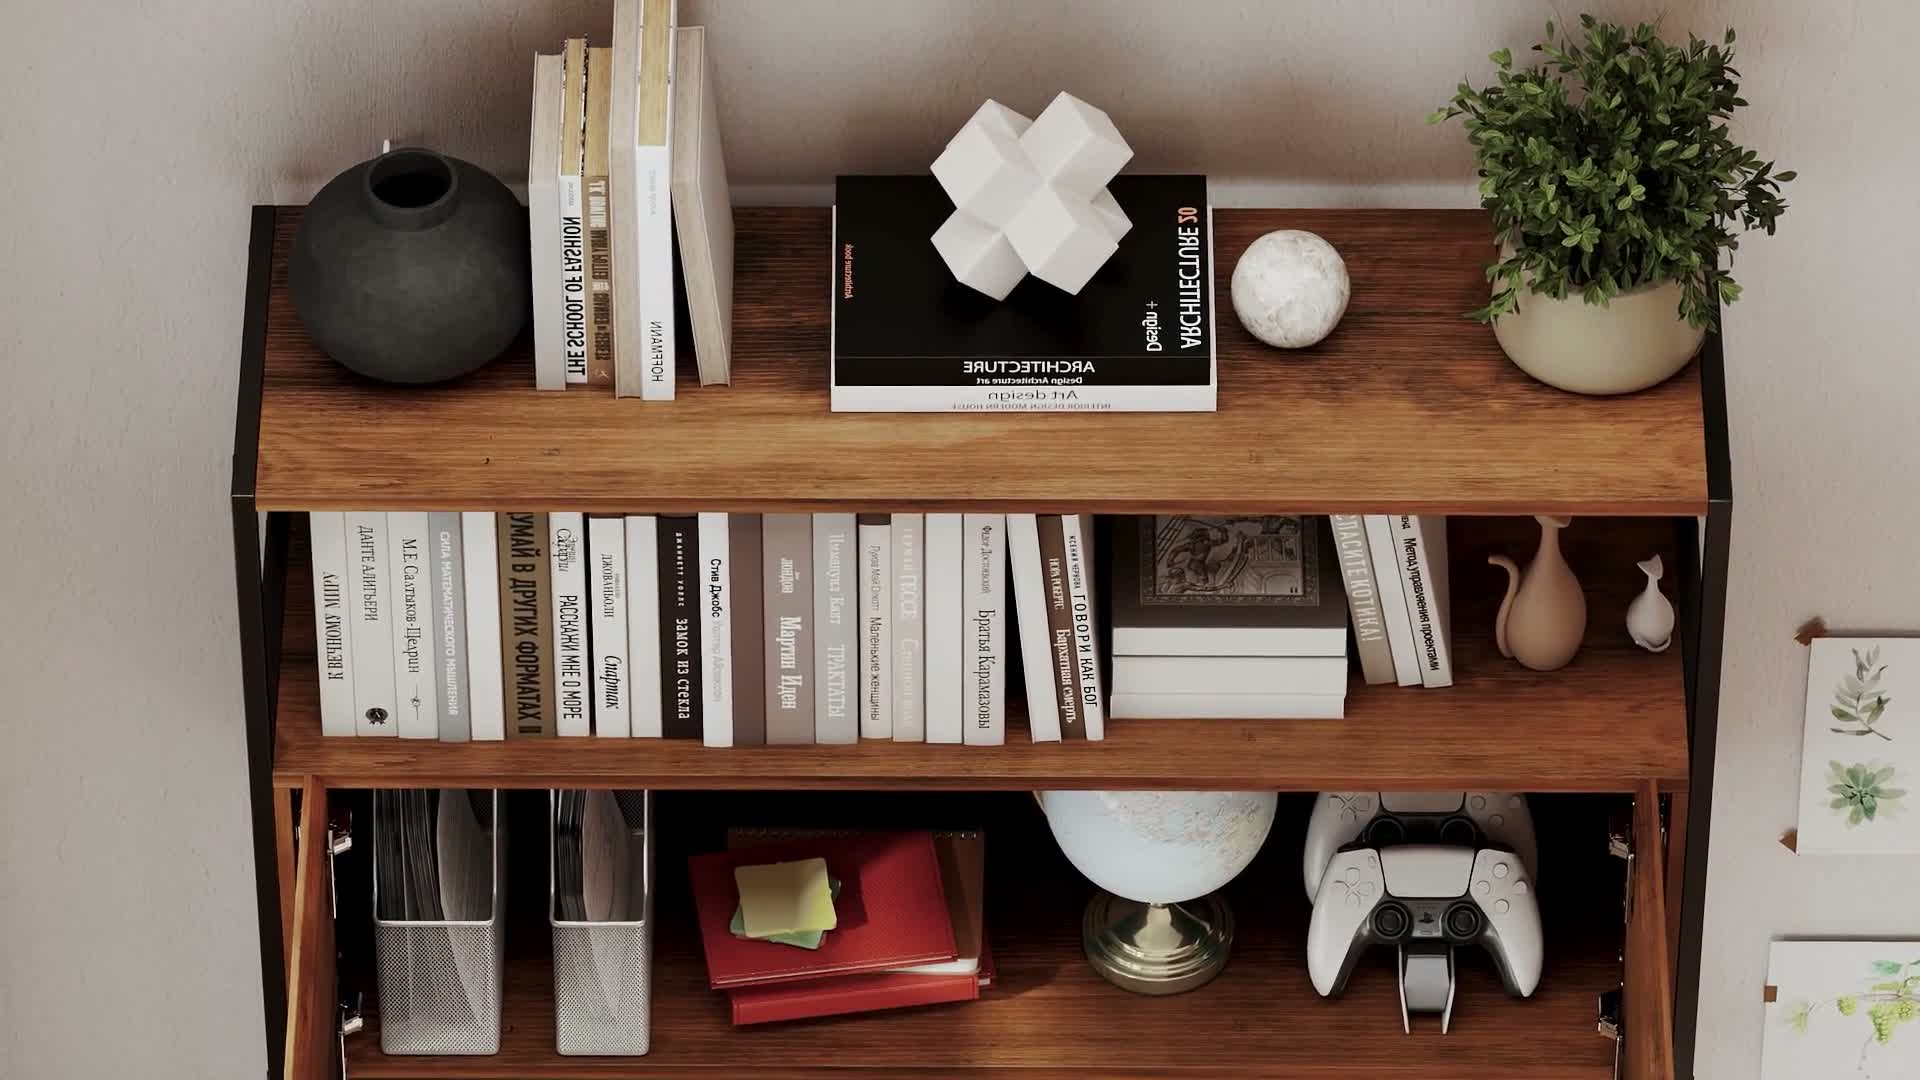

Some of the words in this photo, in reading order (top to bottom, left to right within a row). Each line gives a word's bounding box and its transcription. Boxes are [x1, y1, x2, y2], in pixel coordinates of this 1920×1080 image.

[359, 525, 375, 563] ДАНТЕ
[403, 538, 418, 563] М.Е.
[440, 531, 452, 559] СИЛА
[512, 563, 536, 573] В
[1403, 537, 1418, 566] Метод
[362, 565, 378, 621] АЛИГЬЕРИ
[602, 553, 615, 618] ДЖОВАНЬОЛИ
[710, 558, 721, 582] Стив
[1409, 566, 1430, 623] управления
[403, 565, 420, 673] Салтыков-Щедрин
[440, 560, 456, 657] МАТЕМАТИЧЕСКОГО
[510, 578, 538, 637] ДРУГИХ
[710, 585, 722, 618] Джобс
[830, 597, 844, 624] Кант
[1051, 581, 1065, 610] РОБЕРТС
[1351, 579, 1383, 641] КОТИКА!
[325, 613, 344, 670] ВЕЧНОМУ
[559, 595, 580, 651] РАССКАЖИ
[776, 616, 802, 668] Мартин
[870, 617, 882, 671] Маленькие
[973, 609, 995, 652] Братья
[1074, 595, 1092, 654] ГОВОРИ
[1420, 622, 1440, 671] проектами
[328, 672, 344, 681] К
[514, 641, 542, 721] ФОРМАТАХ
[562, 654, 581, 677] МНЕ
[828, 644, 846, 718] ТРАКТАТЫ
[1055, 628, 1073, 686] Бархатная
[1081, 658, 1095, 681] КАК
[446, 659, 458, 715] МЫШЛЕНИЯ
[563, 689, 582, 720] МОРЕ
[600, 655, 622, 709] Спартак
[778, 675, 802, 709] Иден
[870, 673, 880, 721] женщины
[973, 655, 995, 729] Карамазовы
[1061, 686, 1077, 724] смерть
[1084, 687, 1098, 708] БОГ
